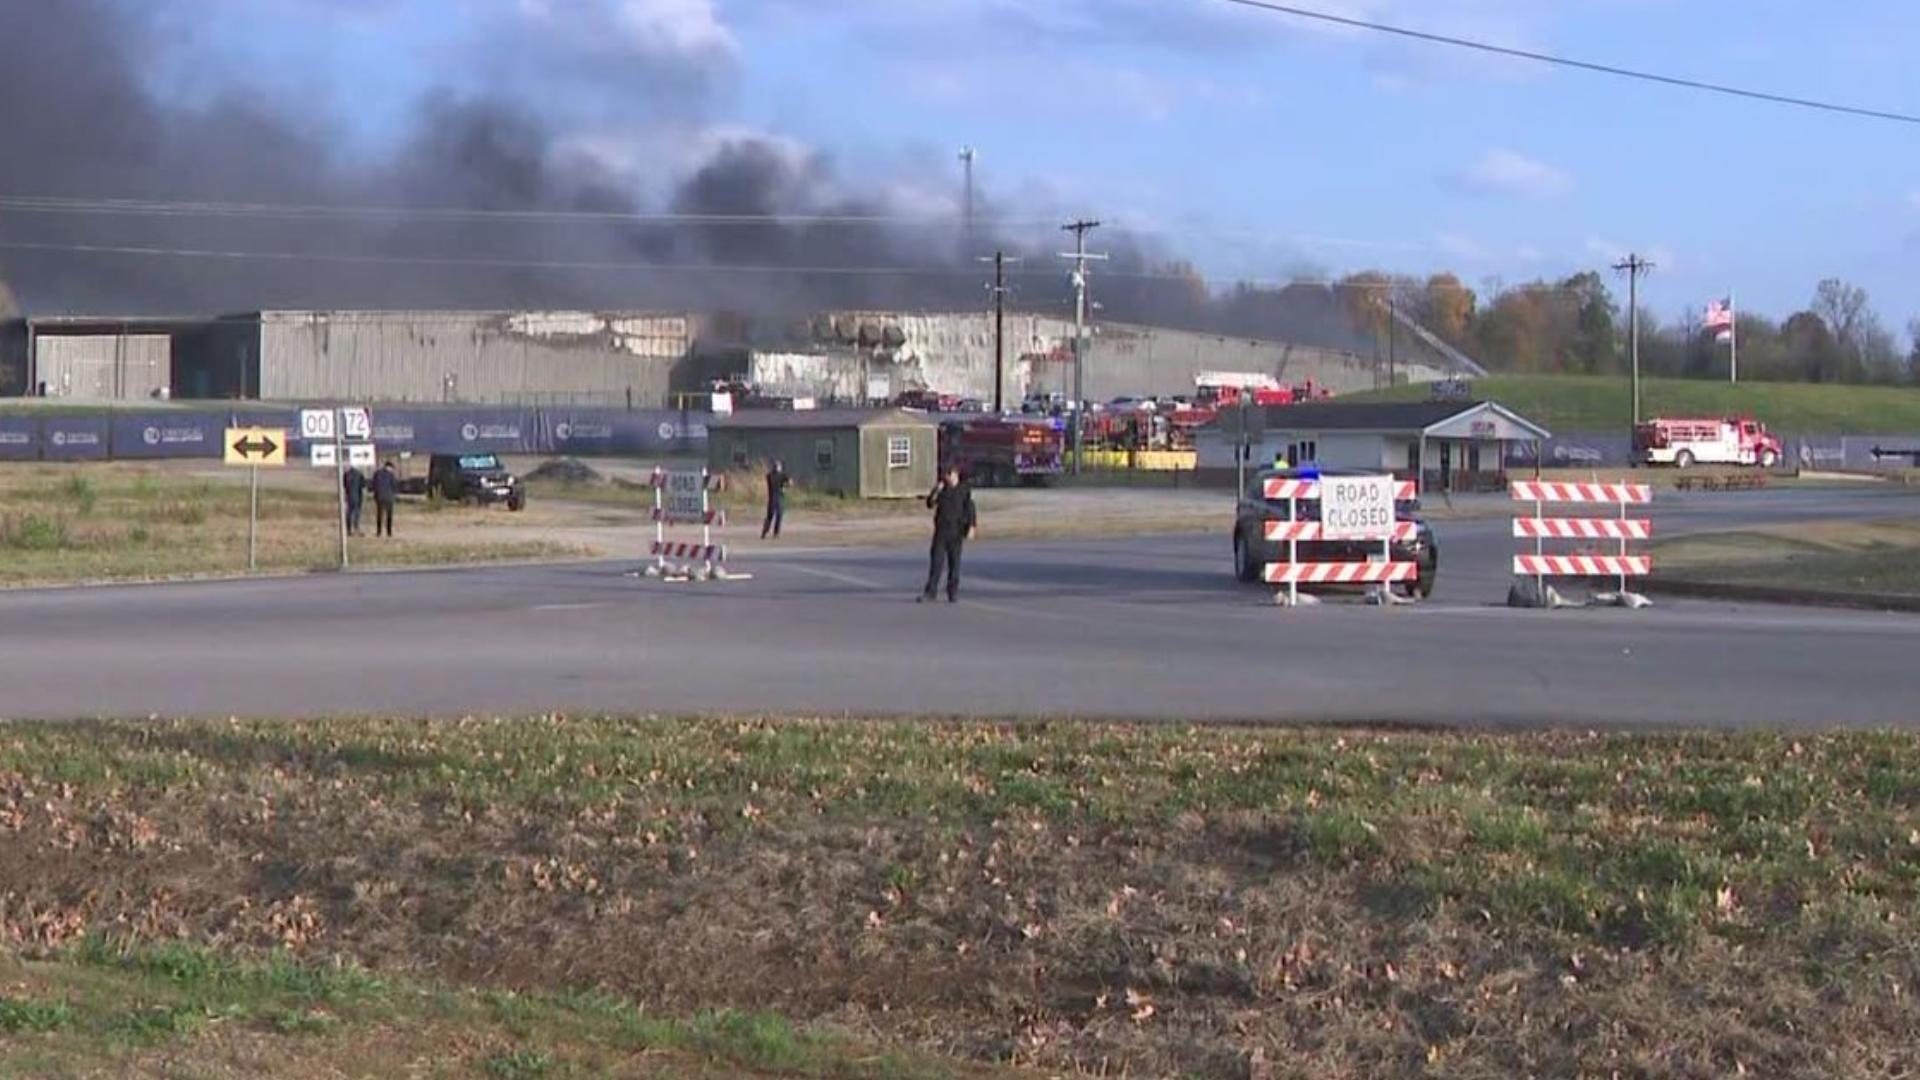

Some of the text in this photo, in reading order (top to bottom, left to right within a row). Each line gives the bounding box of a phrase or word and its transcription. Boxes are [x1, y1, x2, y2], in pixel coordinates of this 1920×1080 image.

[349, 412, 366, 432] 72
[1336, 483, 1379, 501] ROAD
[1328, 507, 1388, 527] CLOSED
